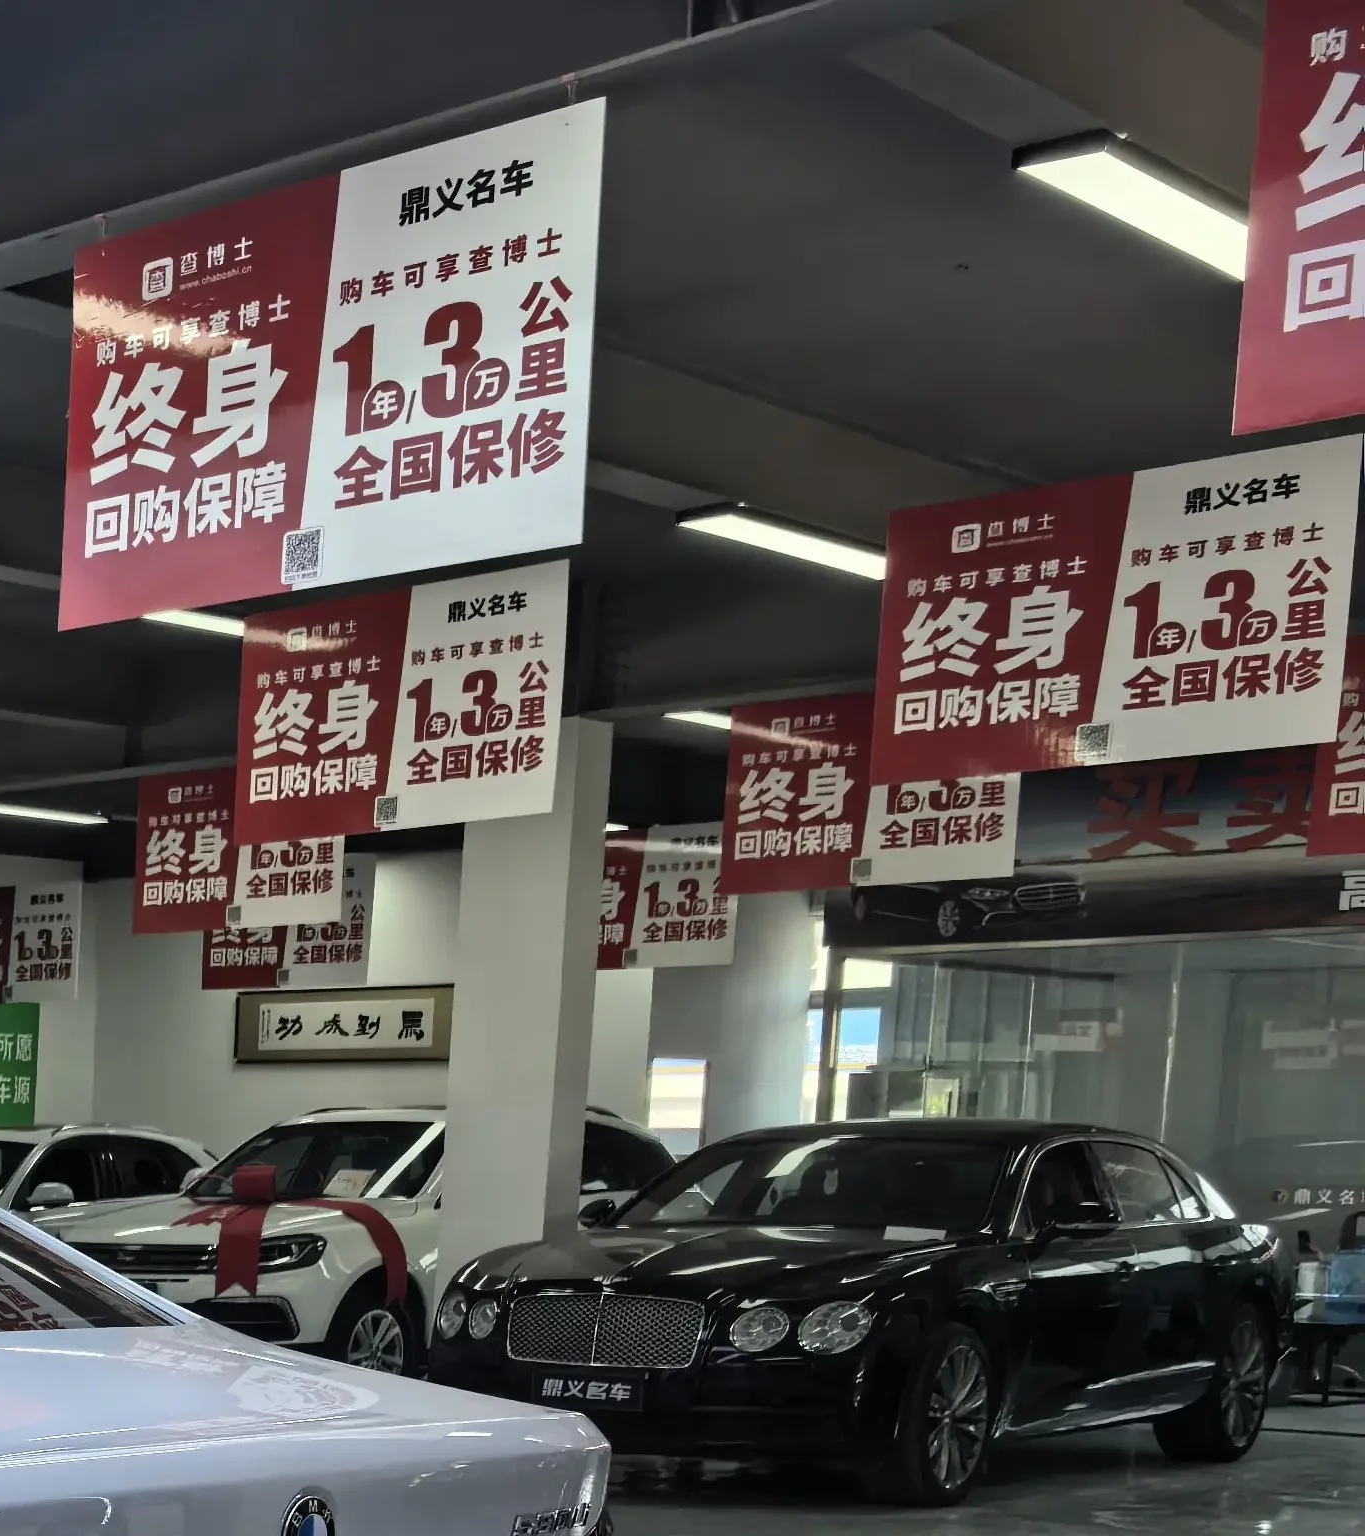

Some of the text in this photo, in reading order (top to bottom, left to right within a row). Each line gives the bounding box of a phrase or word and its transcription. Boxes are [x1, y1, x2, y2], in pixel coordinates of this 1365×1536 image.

[1310, 27, 1365, 66] 购
[398, 159, 534, 227] 鼎义名车
[180, 236, 253, 276] 查博士
[340, 227, 563, 307] 购车可享查博士
[95, 293, 290, 367] 购车可享查博士
[90, 338, 288, 487] 终身
[334, 408, 567, 510] 全国保修
[84, 461, 287, 559] 回购保障
[1184, 473, 1301, 514] 鼎义名车
[987, 513, 1055, 539] 查博士
[1130, 522, 1325, 568] 购车可享查博士
[907, 555, 1088, 598] 购车可享查博士
[448, 591, 528, 623] 鼎义名车
[411, 631, 545, 667] 购车可享查博士
[900, 584, 1084, 683] 终身
[257, 655, 381, 689] 购车可享查博士
[1122, 647, 1325, 712] 全国保修
[253, 680, 380, 760] 终身
[894, 674, 1080, 735] 回购保障
[249, 753, 378, 804] 回购保障
[407, 735, 544, 786] 全国保修
[737, 761, 854, 825] 终身
[145, 824, 227, 877] 终身
[735, 822, 853, 861] 回购保障
[880, 812, 1005, 850] 全国保修
[143, 877, 227, 907] 回购保障
[246, 869, 334, 899] 全国保修
[643, 918, 728, 943] 全国保修
[293, 943, 363, 965] 全国保修
[1294, 1188, 1365, 1205] 鼎义名
[542, 1379, 631, 1401] 鼎义名车
